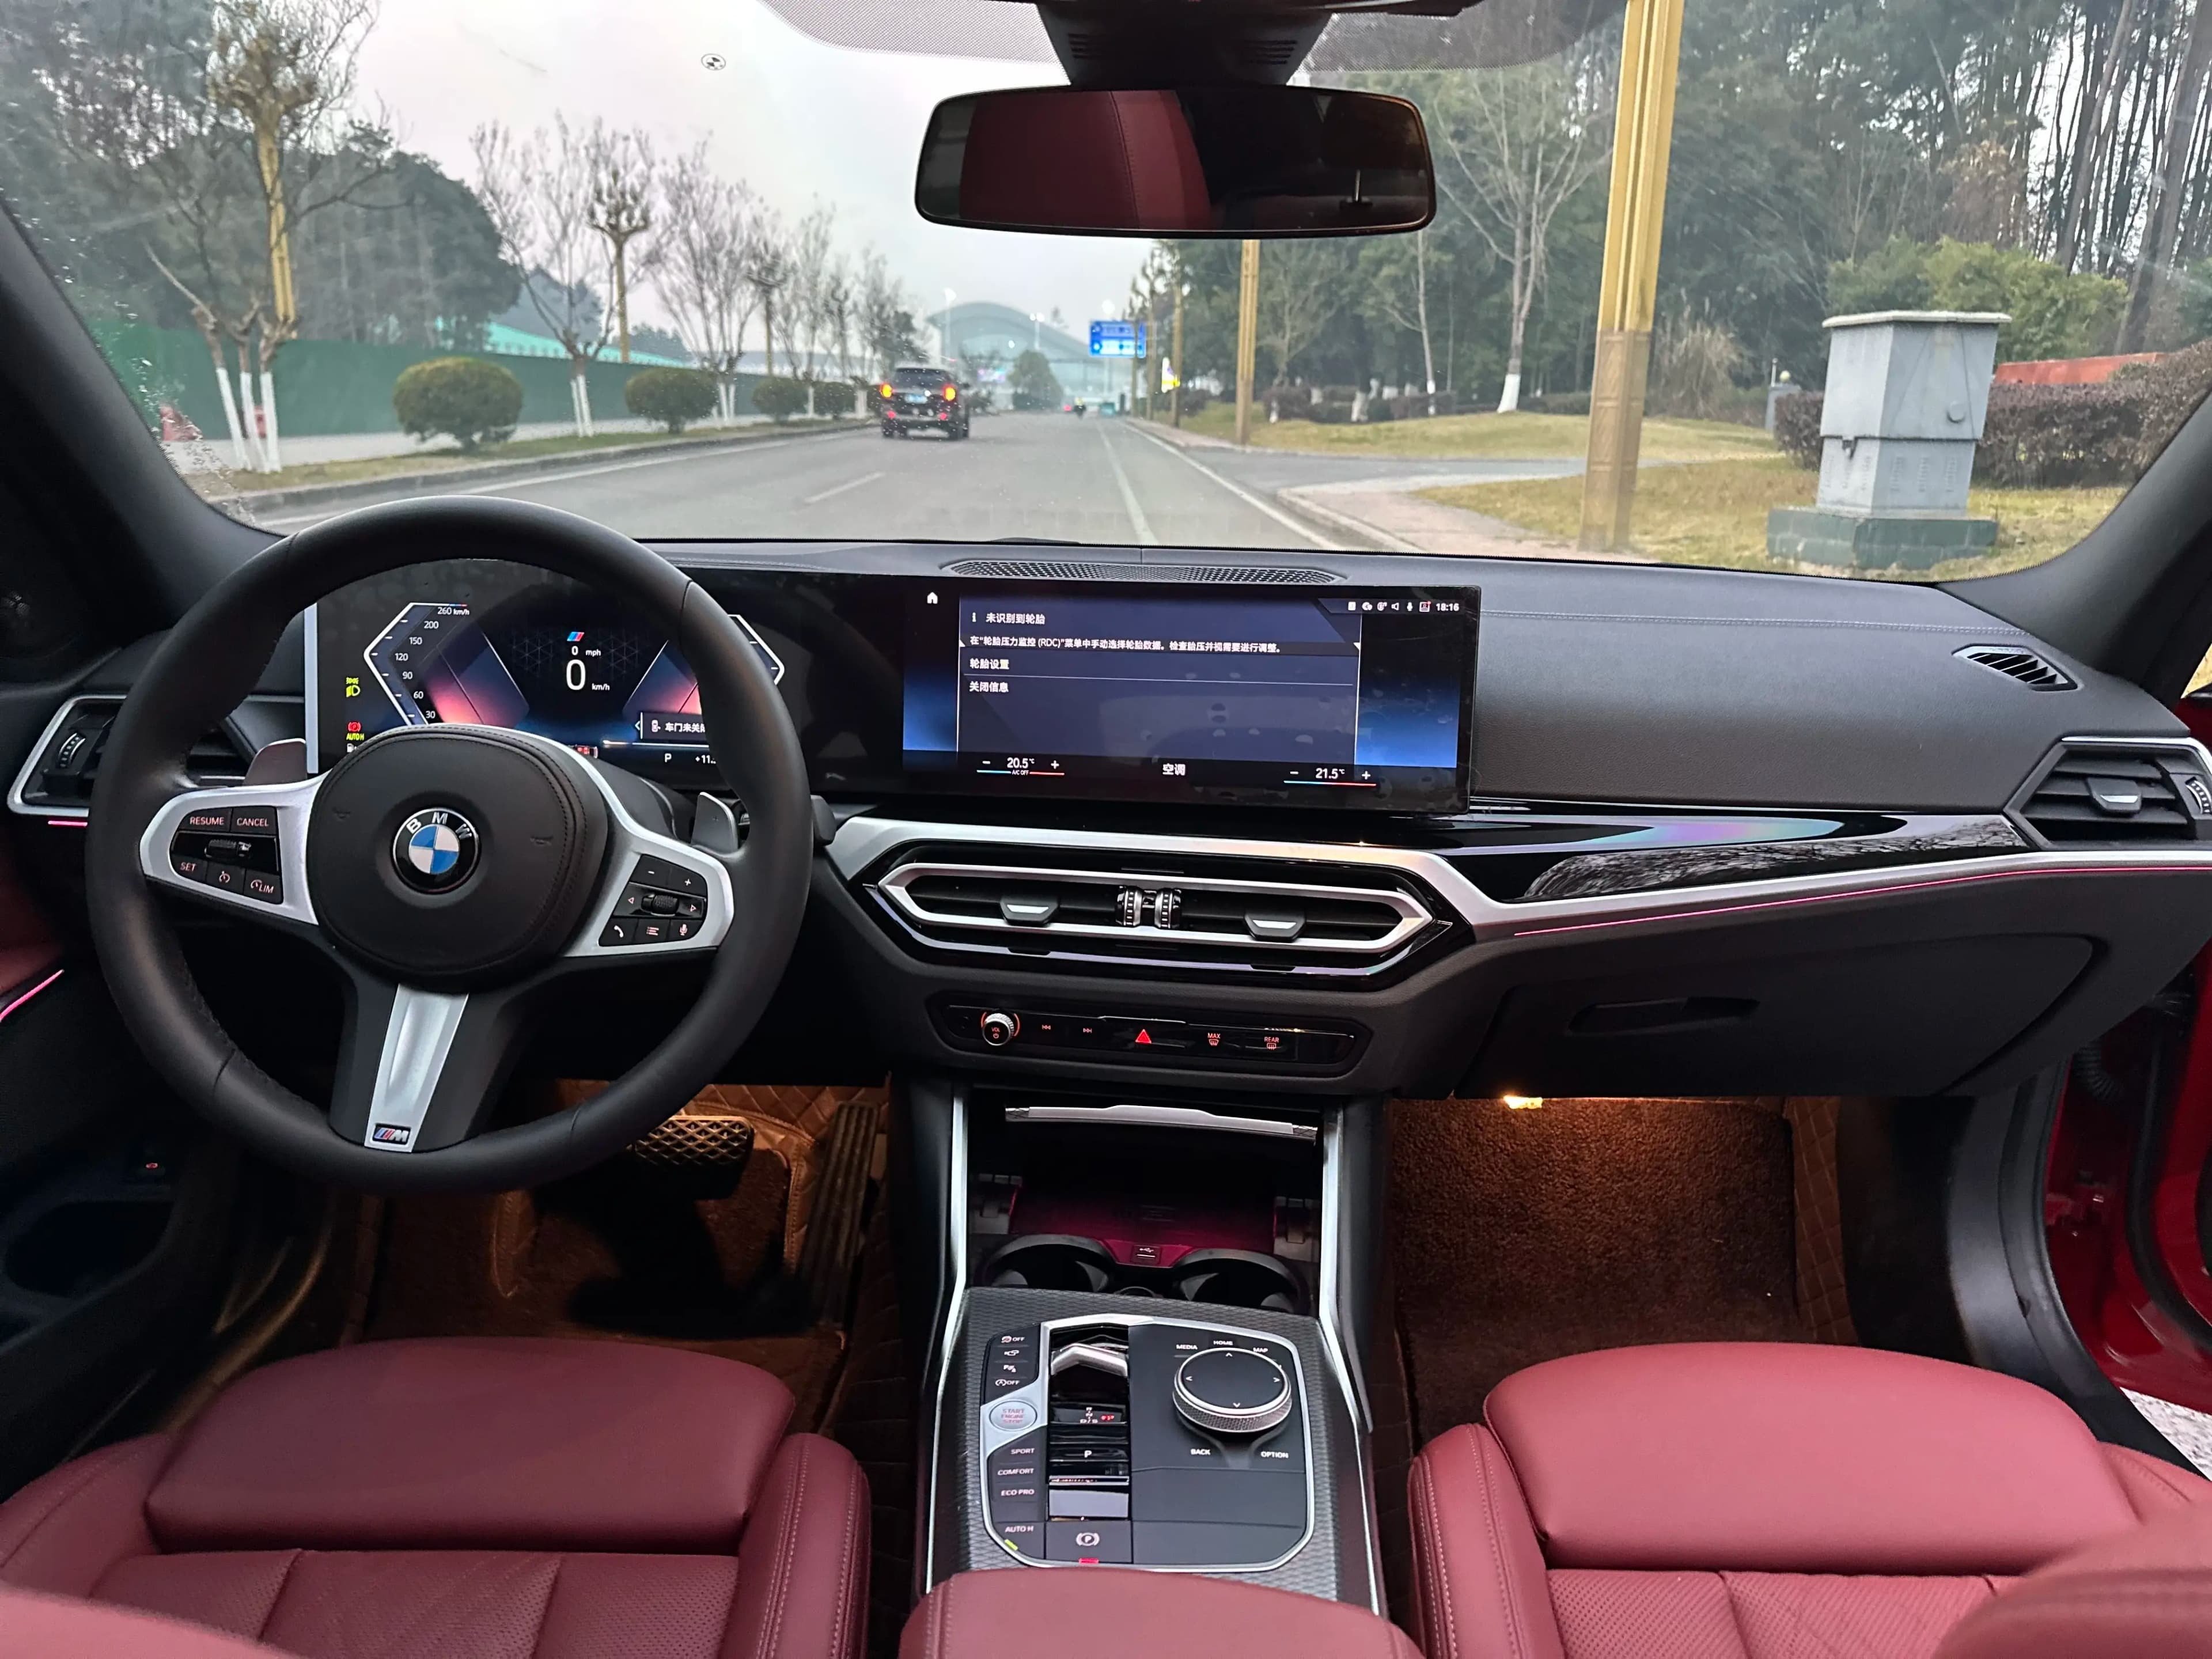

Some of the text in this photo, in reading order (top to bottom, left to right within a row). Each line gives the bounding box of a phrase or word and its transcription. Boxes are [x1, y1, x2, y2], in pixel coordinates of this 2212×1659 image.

[437, 607, 452, 615] 260
[1435, 603, 1460, 611] 18:16
[986, 612, 1046, 625] 未识别到轮胎
[423, 620, 439, 629] 200
[409, 637, 423, 645] 150
[571, 646, 601, 657] 0 mph
[395, 653, 409, 661] 120
[969, 658, 1010, 670] 轮胎设置
[402, 671, 413, 680] 90
[566, 659, 586, 691] 0
[969, 681, 1009, 692] 关闭信息
[413, 691, 424, 699] 60
[425, 710, 435, 719] 30
[664, 753, 672, 763] P
[1162, 763, 1185, 776] 空调
[190, 816, 225, 825] RESUME
[236, 817, 269, 827] CANCEL
[406, 811, 472, 840] BMW
[180, 862, 196, 872] SET
[259, 882, 275, 893] LIM
[1084, 1450, 1092, 1458] P
